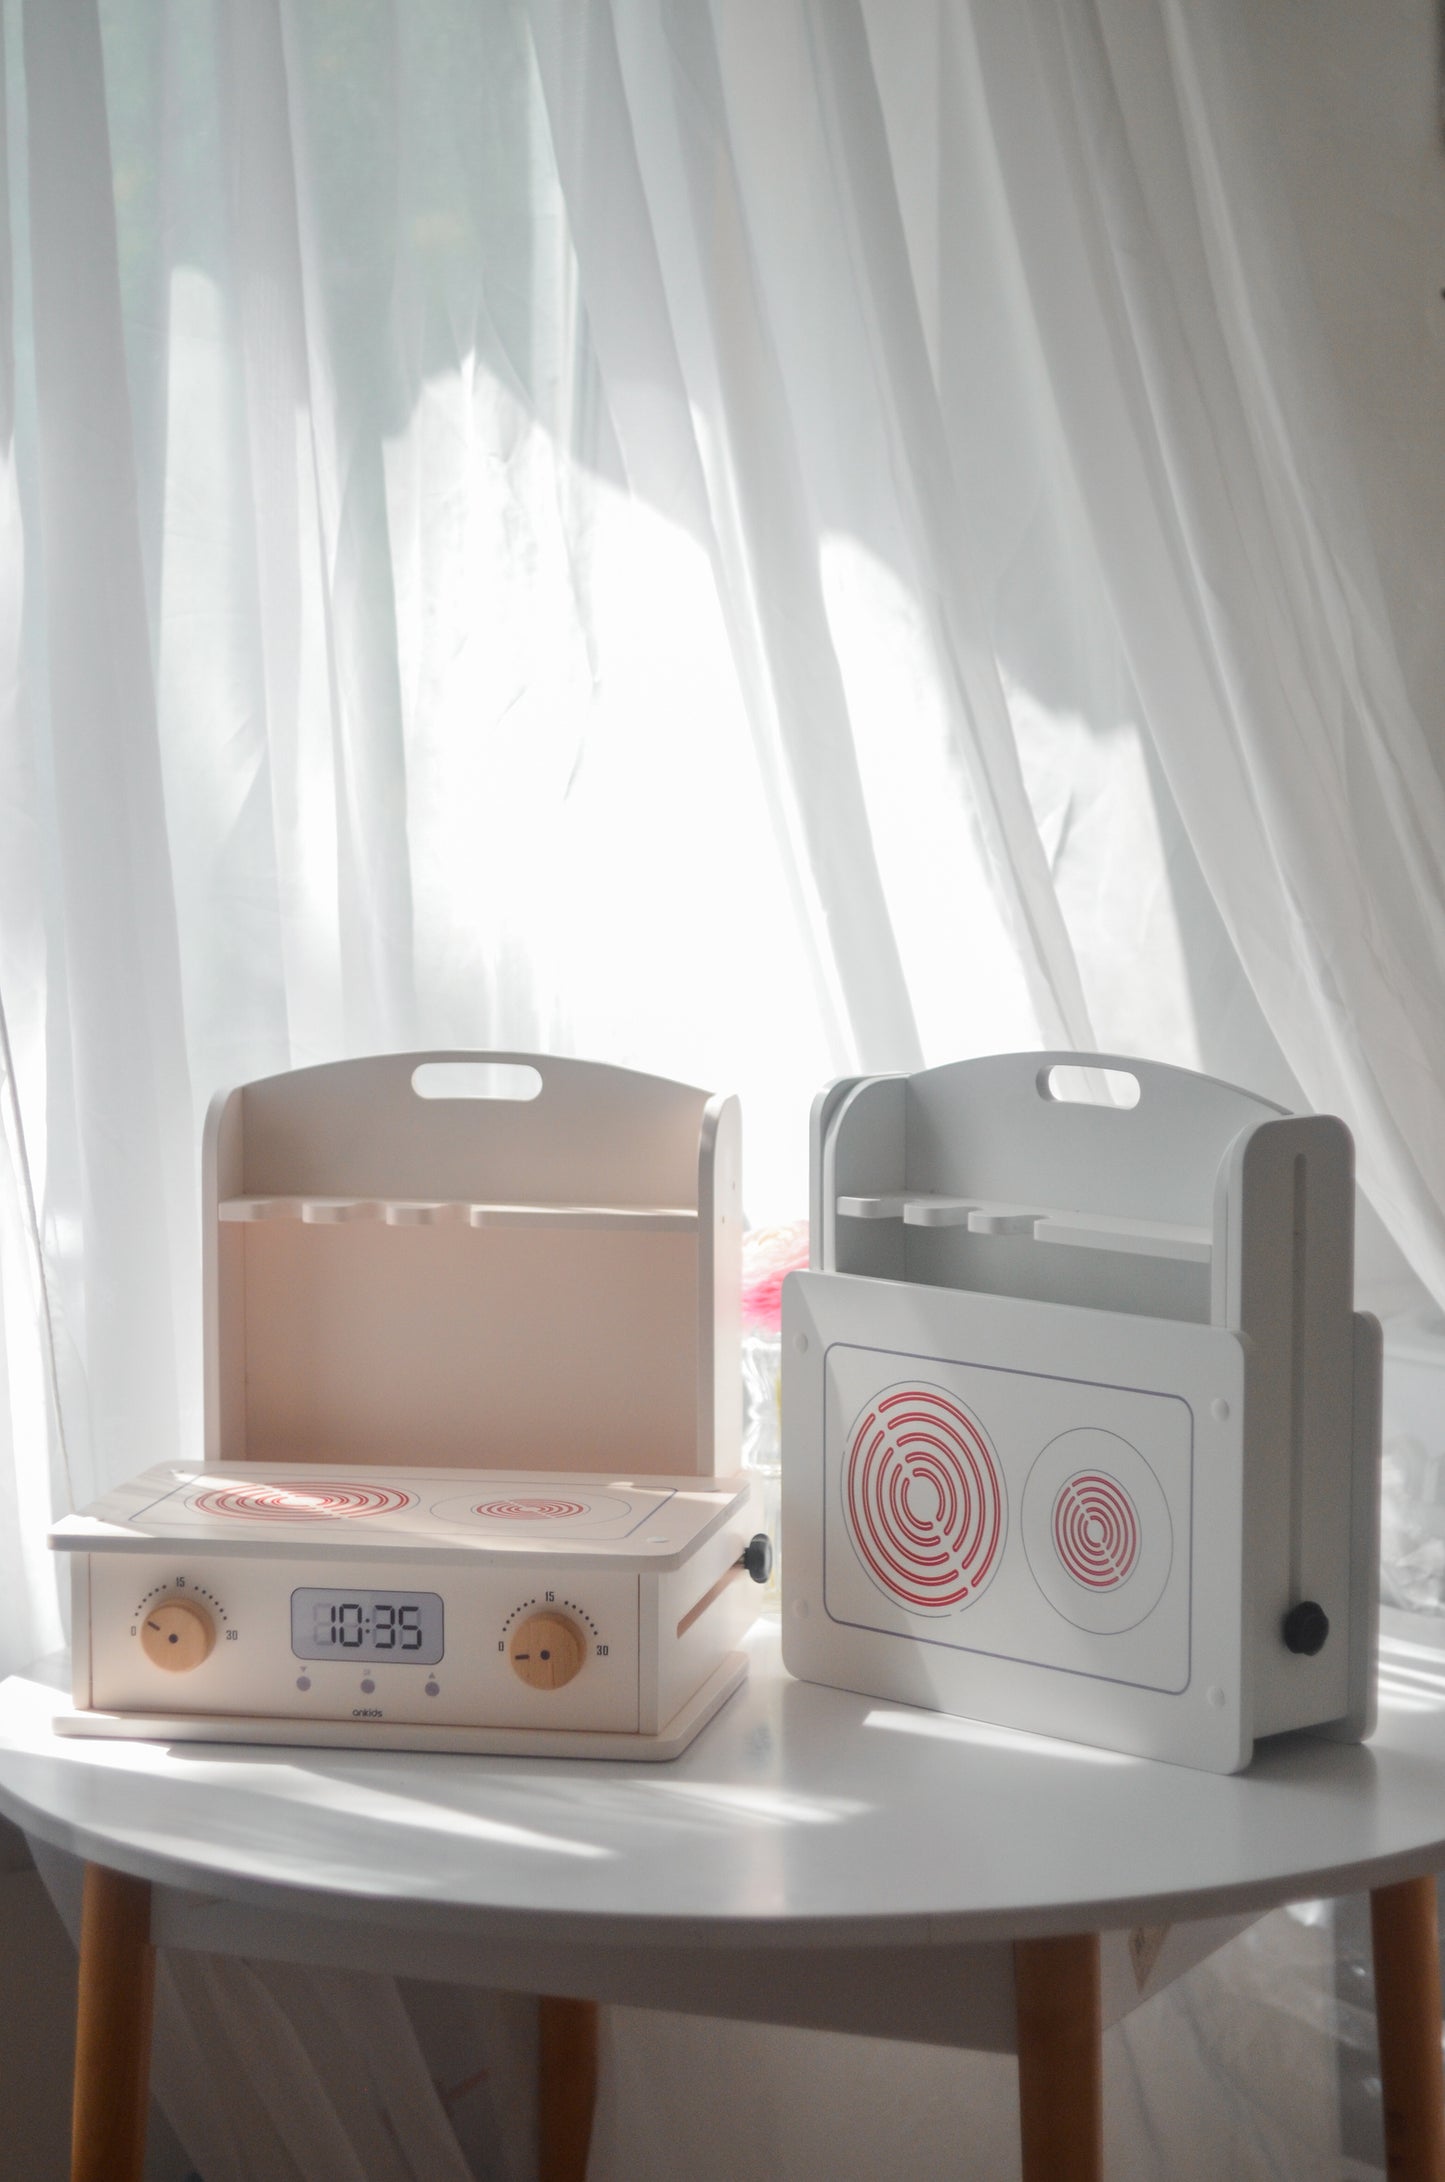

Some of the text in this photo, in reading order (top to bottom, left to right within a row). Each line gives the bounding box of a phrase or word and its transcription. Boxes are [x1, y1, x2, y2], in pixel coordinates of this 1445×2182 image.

[176, 1577, 185, 1587] 15
[545, 1591, 555, 1602] 15
[331, 1604, 422, 1650] 10:35
[226, 1630, 238, 1640] 30
[498, 1641, 504, 1651] 0
[596, 1645, 608, 1655] 30
